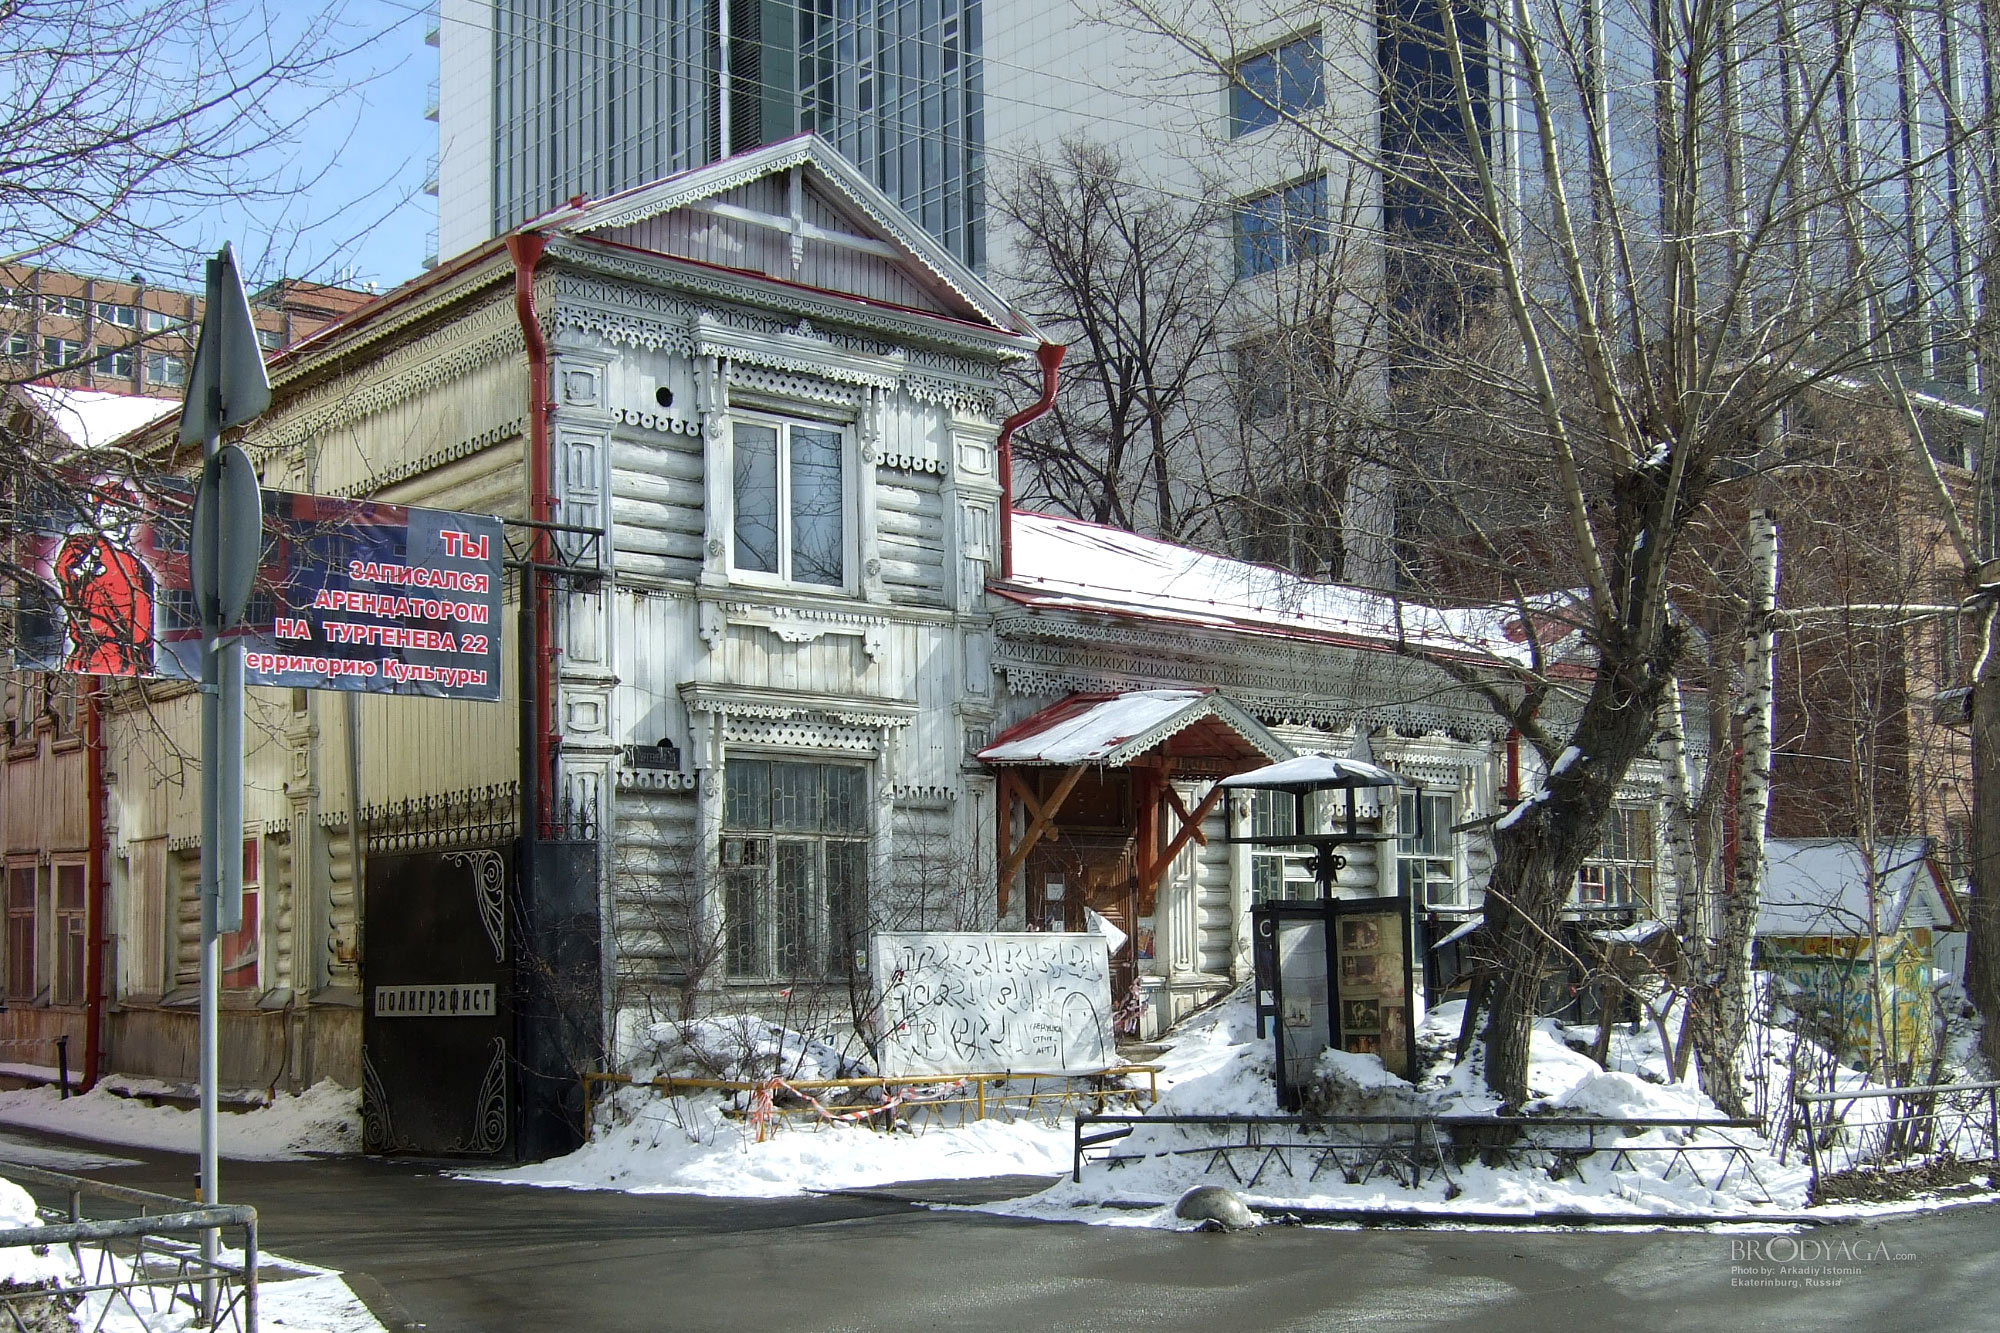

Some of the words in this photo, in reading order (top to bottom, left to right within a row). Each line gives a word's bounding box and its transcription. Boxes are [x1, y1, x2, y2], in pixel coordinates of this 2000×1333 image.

[440, 530, 489, 560] ТЫ
[349, 561, 488, 593] ЗАПИСАЛСЯ
[315, 589, 489, 625] АРЕНДАТОРОМ
[275, 618, 311, 640] НА
[323, 621, 456, 652] ТУРГЕНЕВА
[461, 635, 489, 654] 22
[240, 648, 376, 678] ерриторию
[383, 659, 487, 686] Культуры
[378, 988, 490, 1014] полиграфист
